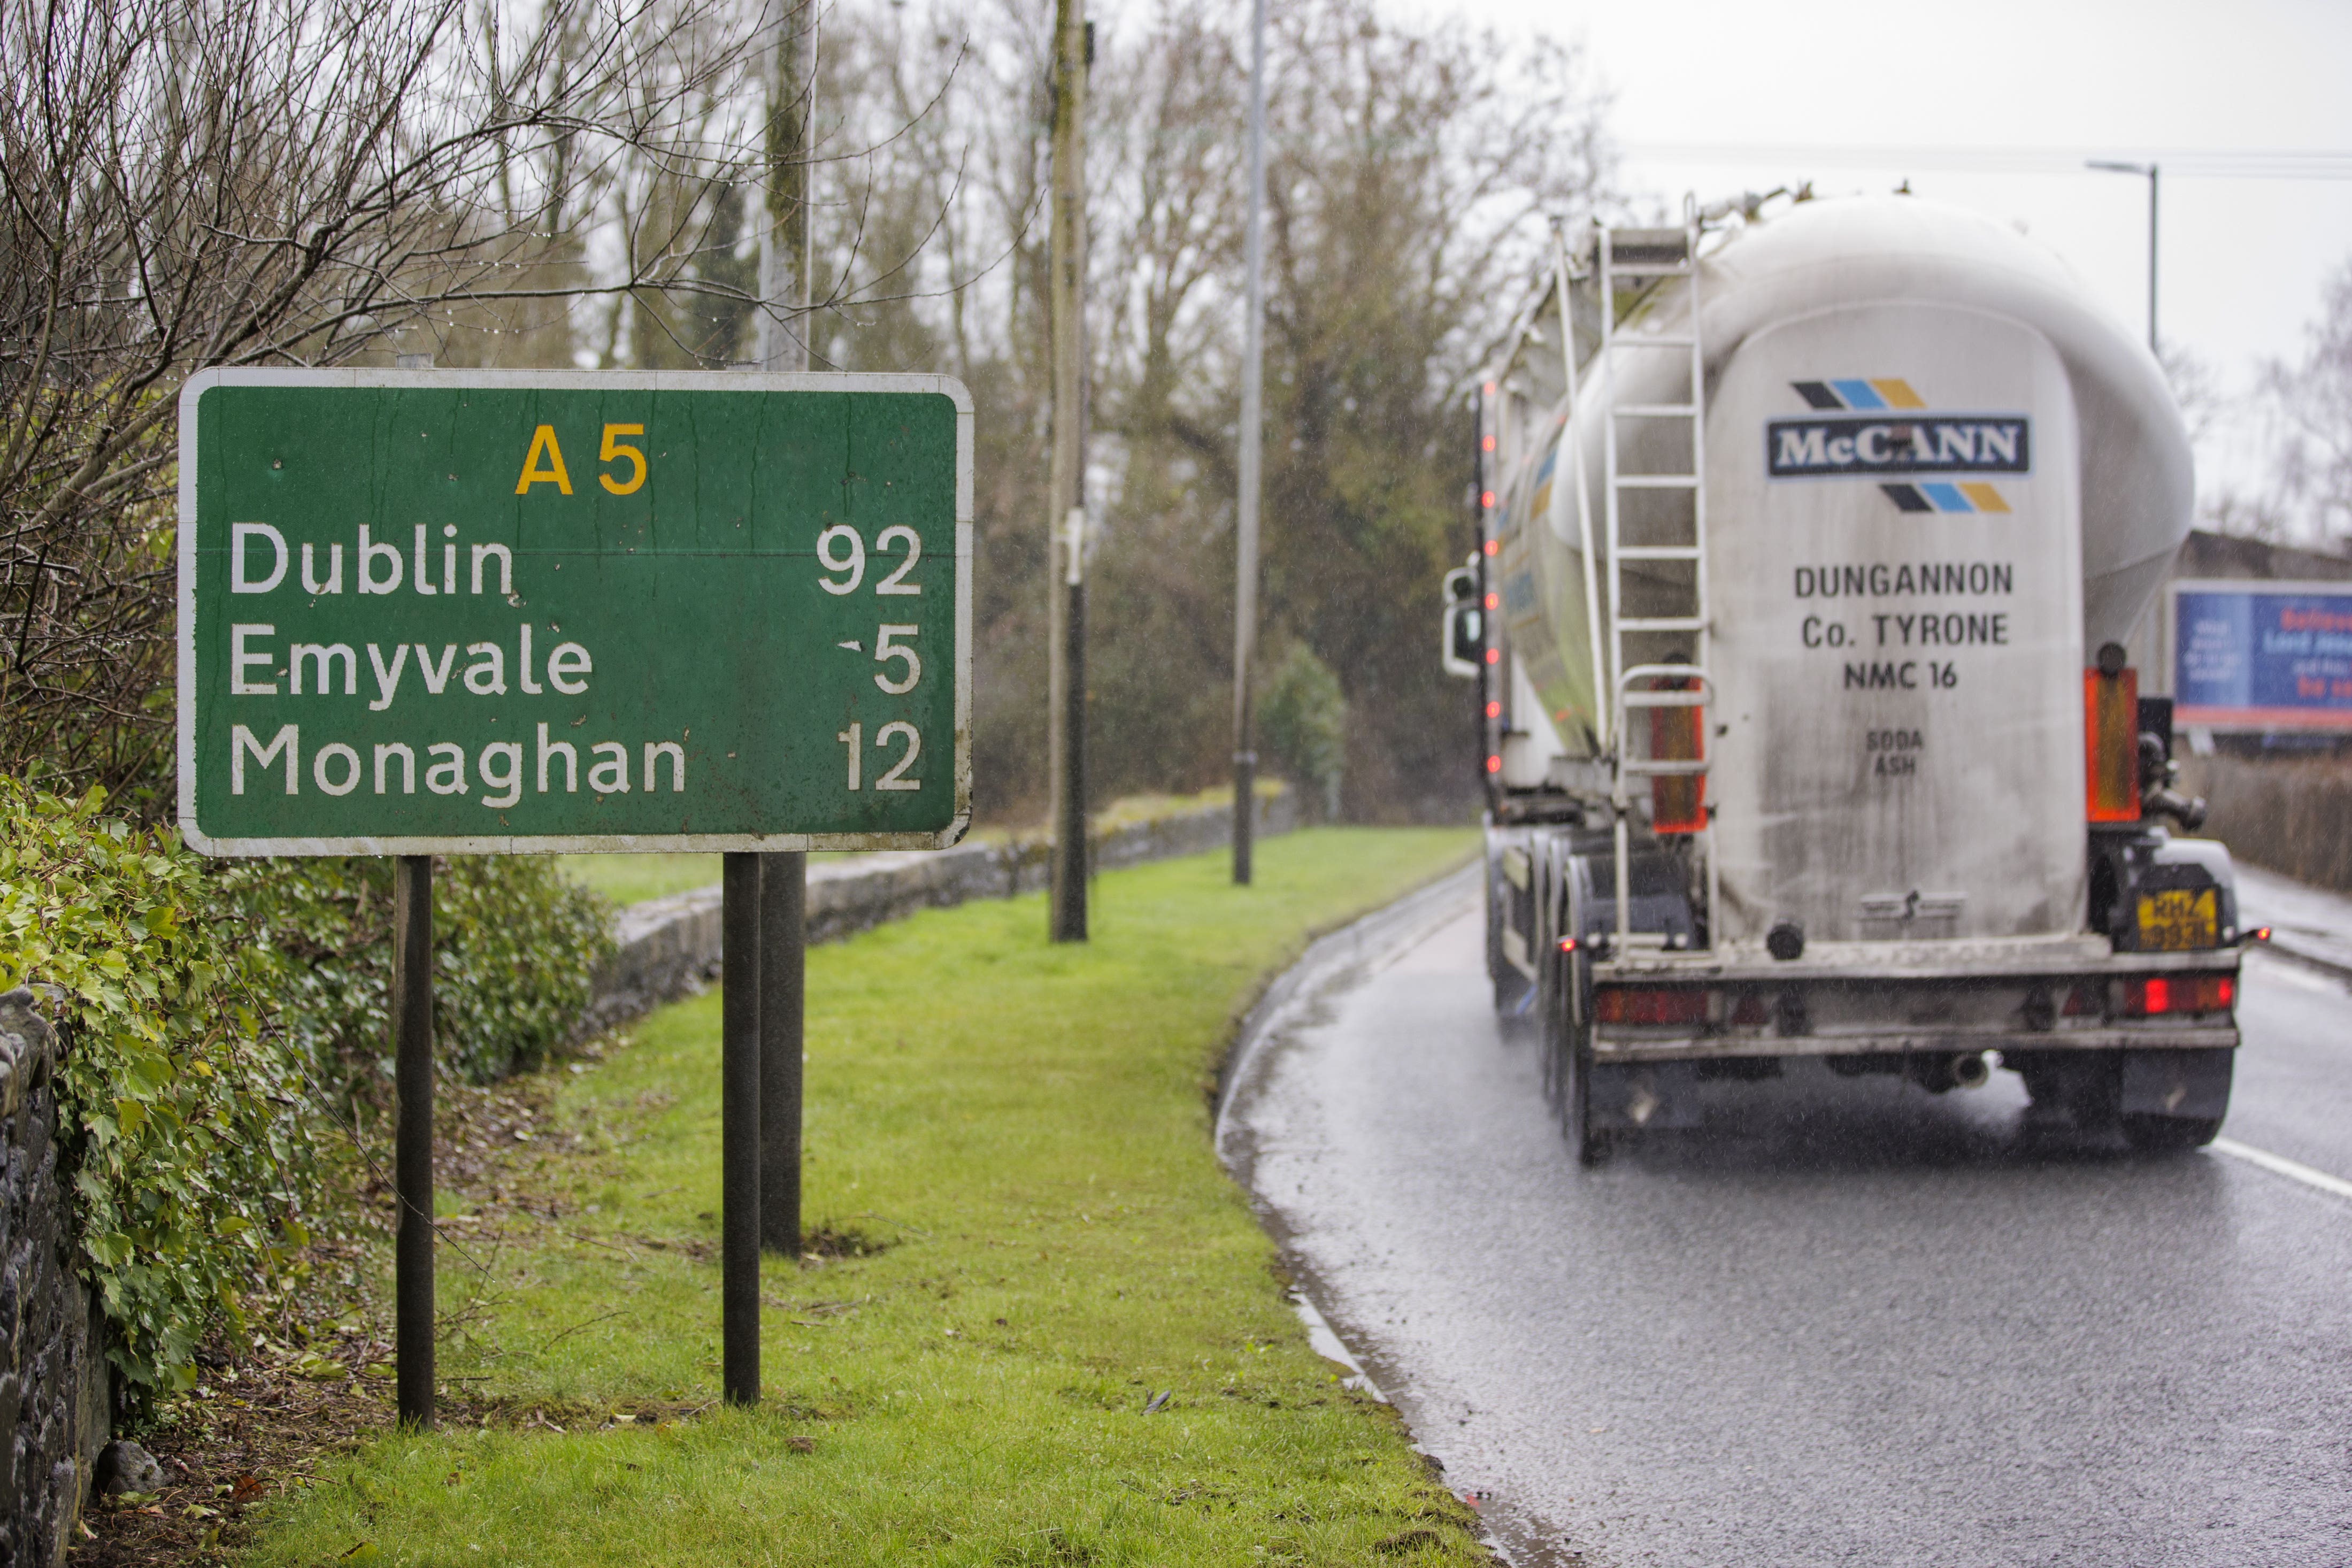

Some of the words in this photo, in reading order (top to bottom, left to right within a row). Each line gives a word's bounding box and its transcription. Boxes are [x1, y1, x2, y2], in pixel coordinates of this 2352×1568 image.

[1776, 425, 2019, 467] McCANN
[230, 522, 513, 596] Dublin
[816, 524, 922, 596] 92
[1794, 563, 2013, 598] DUNGANNON
[1802, 614, 1856, 648] Co.
[1872, 612, 2009, 648] TYRONE
[230, 622, 593, 712] Emyvale
[873, 622, 922, 695] 5
[1843, 661, 1917, 690] NMC
[1929, 661, 1958, 689] 16
[230, 721, 686, 809] Monaghan
[837, 720, 921, 791] 12
[1874, 755, 1916, 777] ASH
